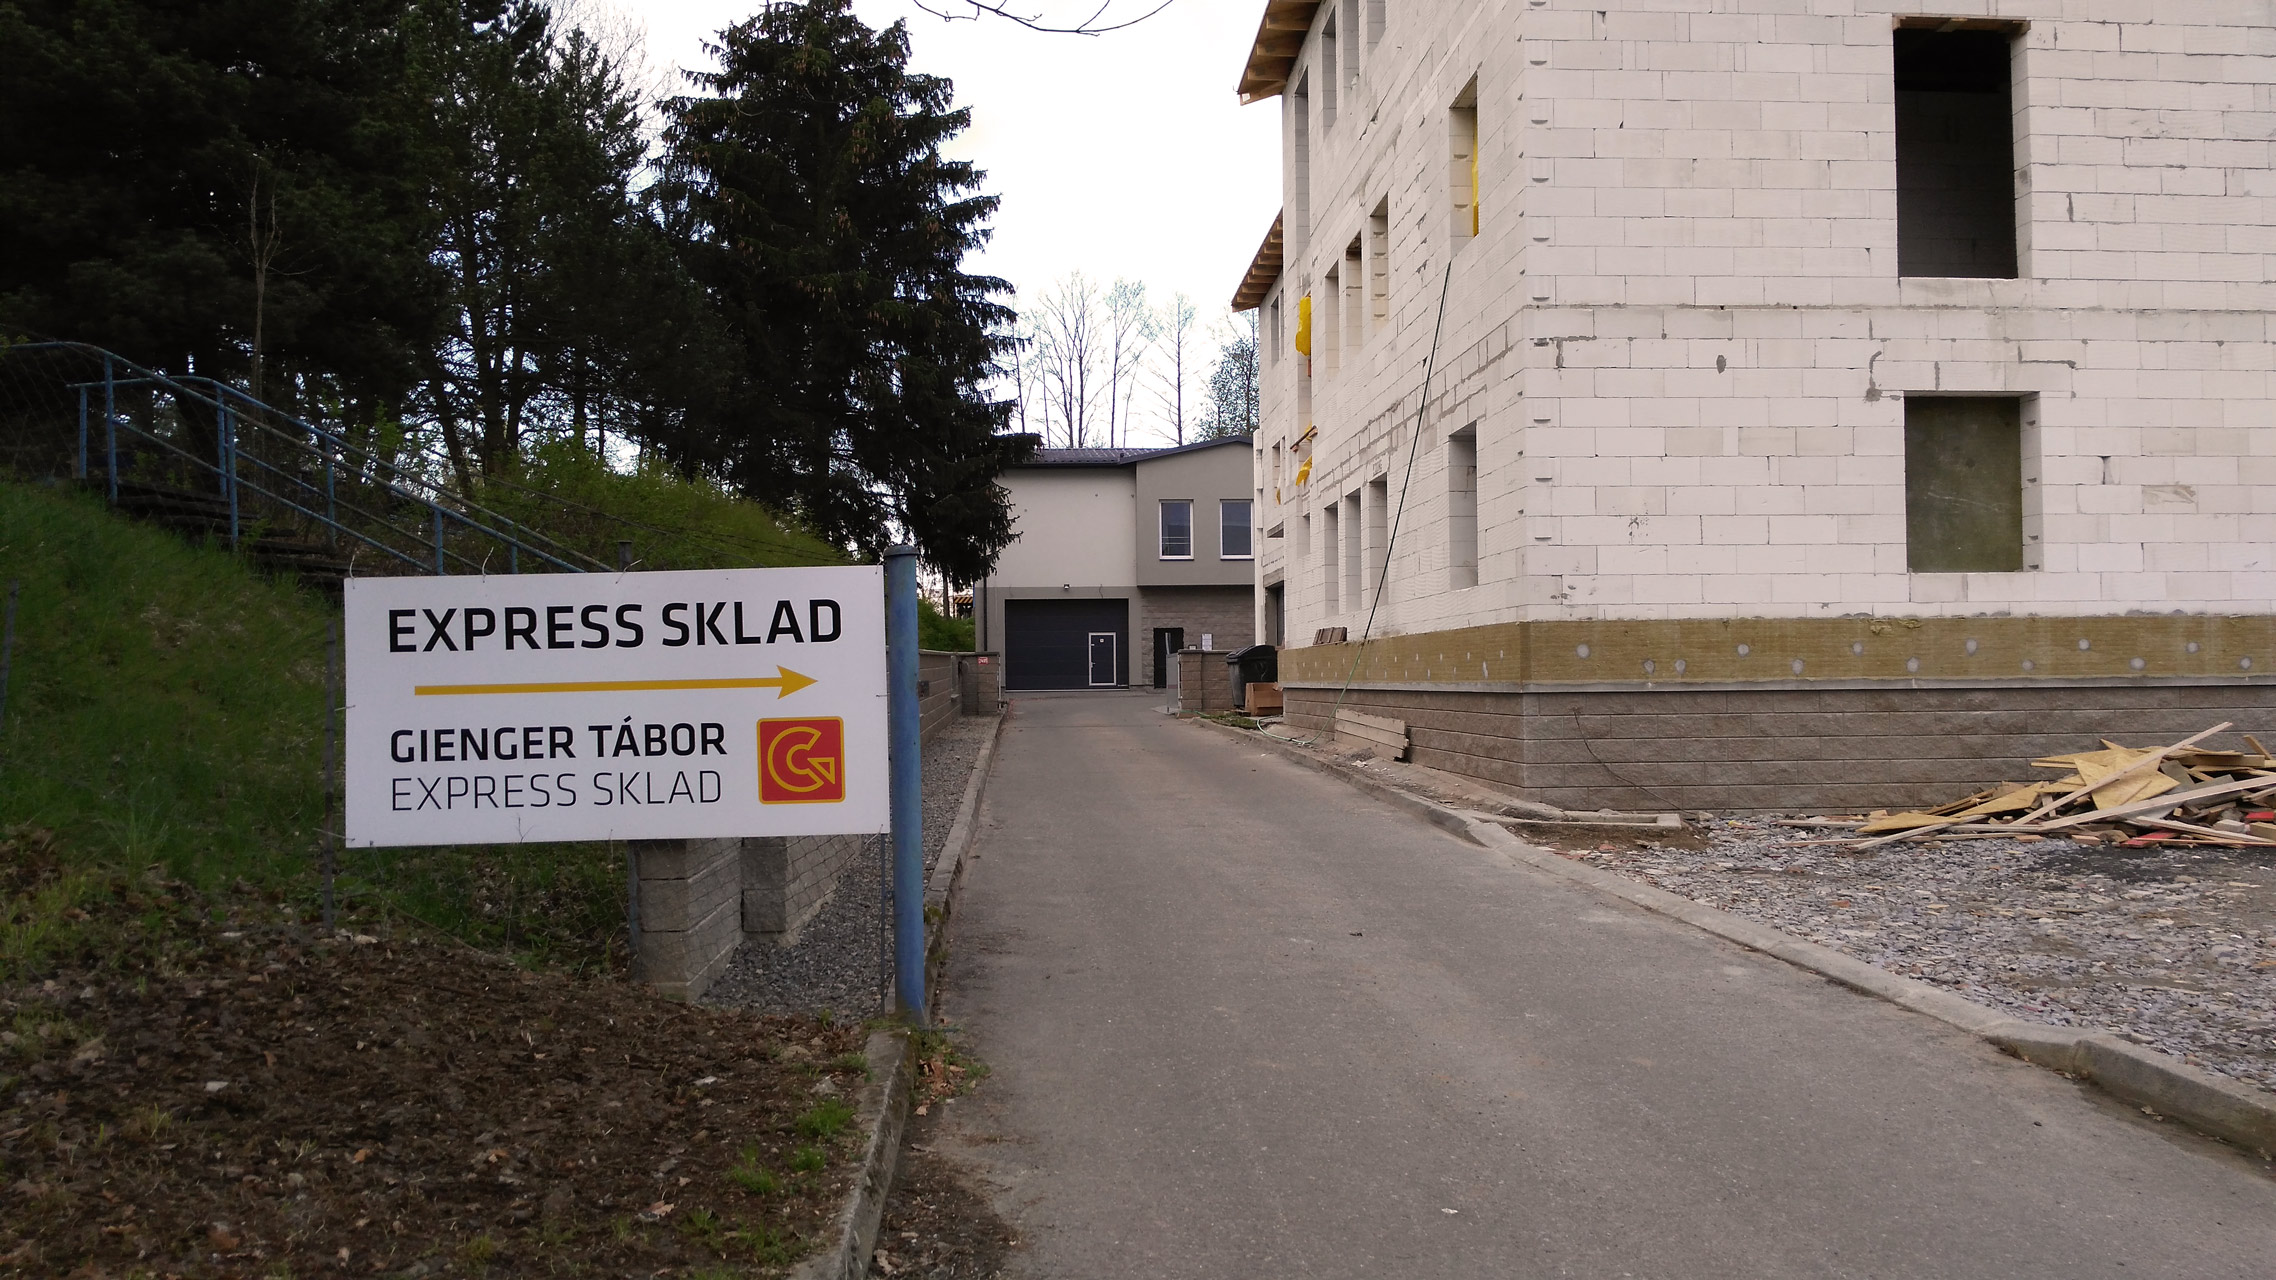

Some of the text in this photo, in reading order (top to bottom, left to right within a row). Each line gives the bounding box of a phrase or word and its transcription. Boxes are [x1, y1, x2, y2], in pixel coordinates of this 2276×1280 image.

[388, 598, 842, 653] EXPRESS SKLAD
[389, 715, 728, 764] GIENGER TÁBOR
[391, 770, 722, 812] EXPRESS SKLAD
